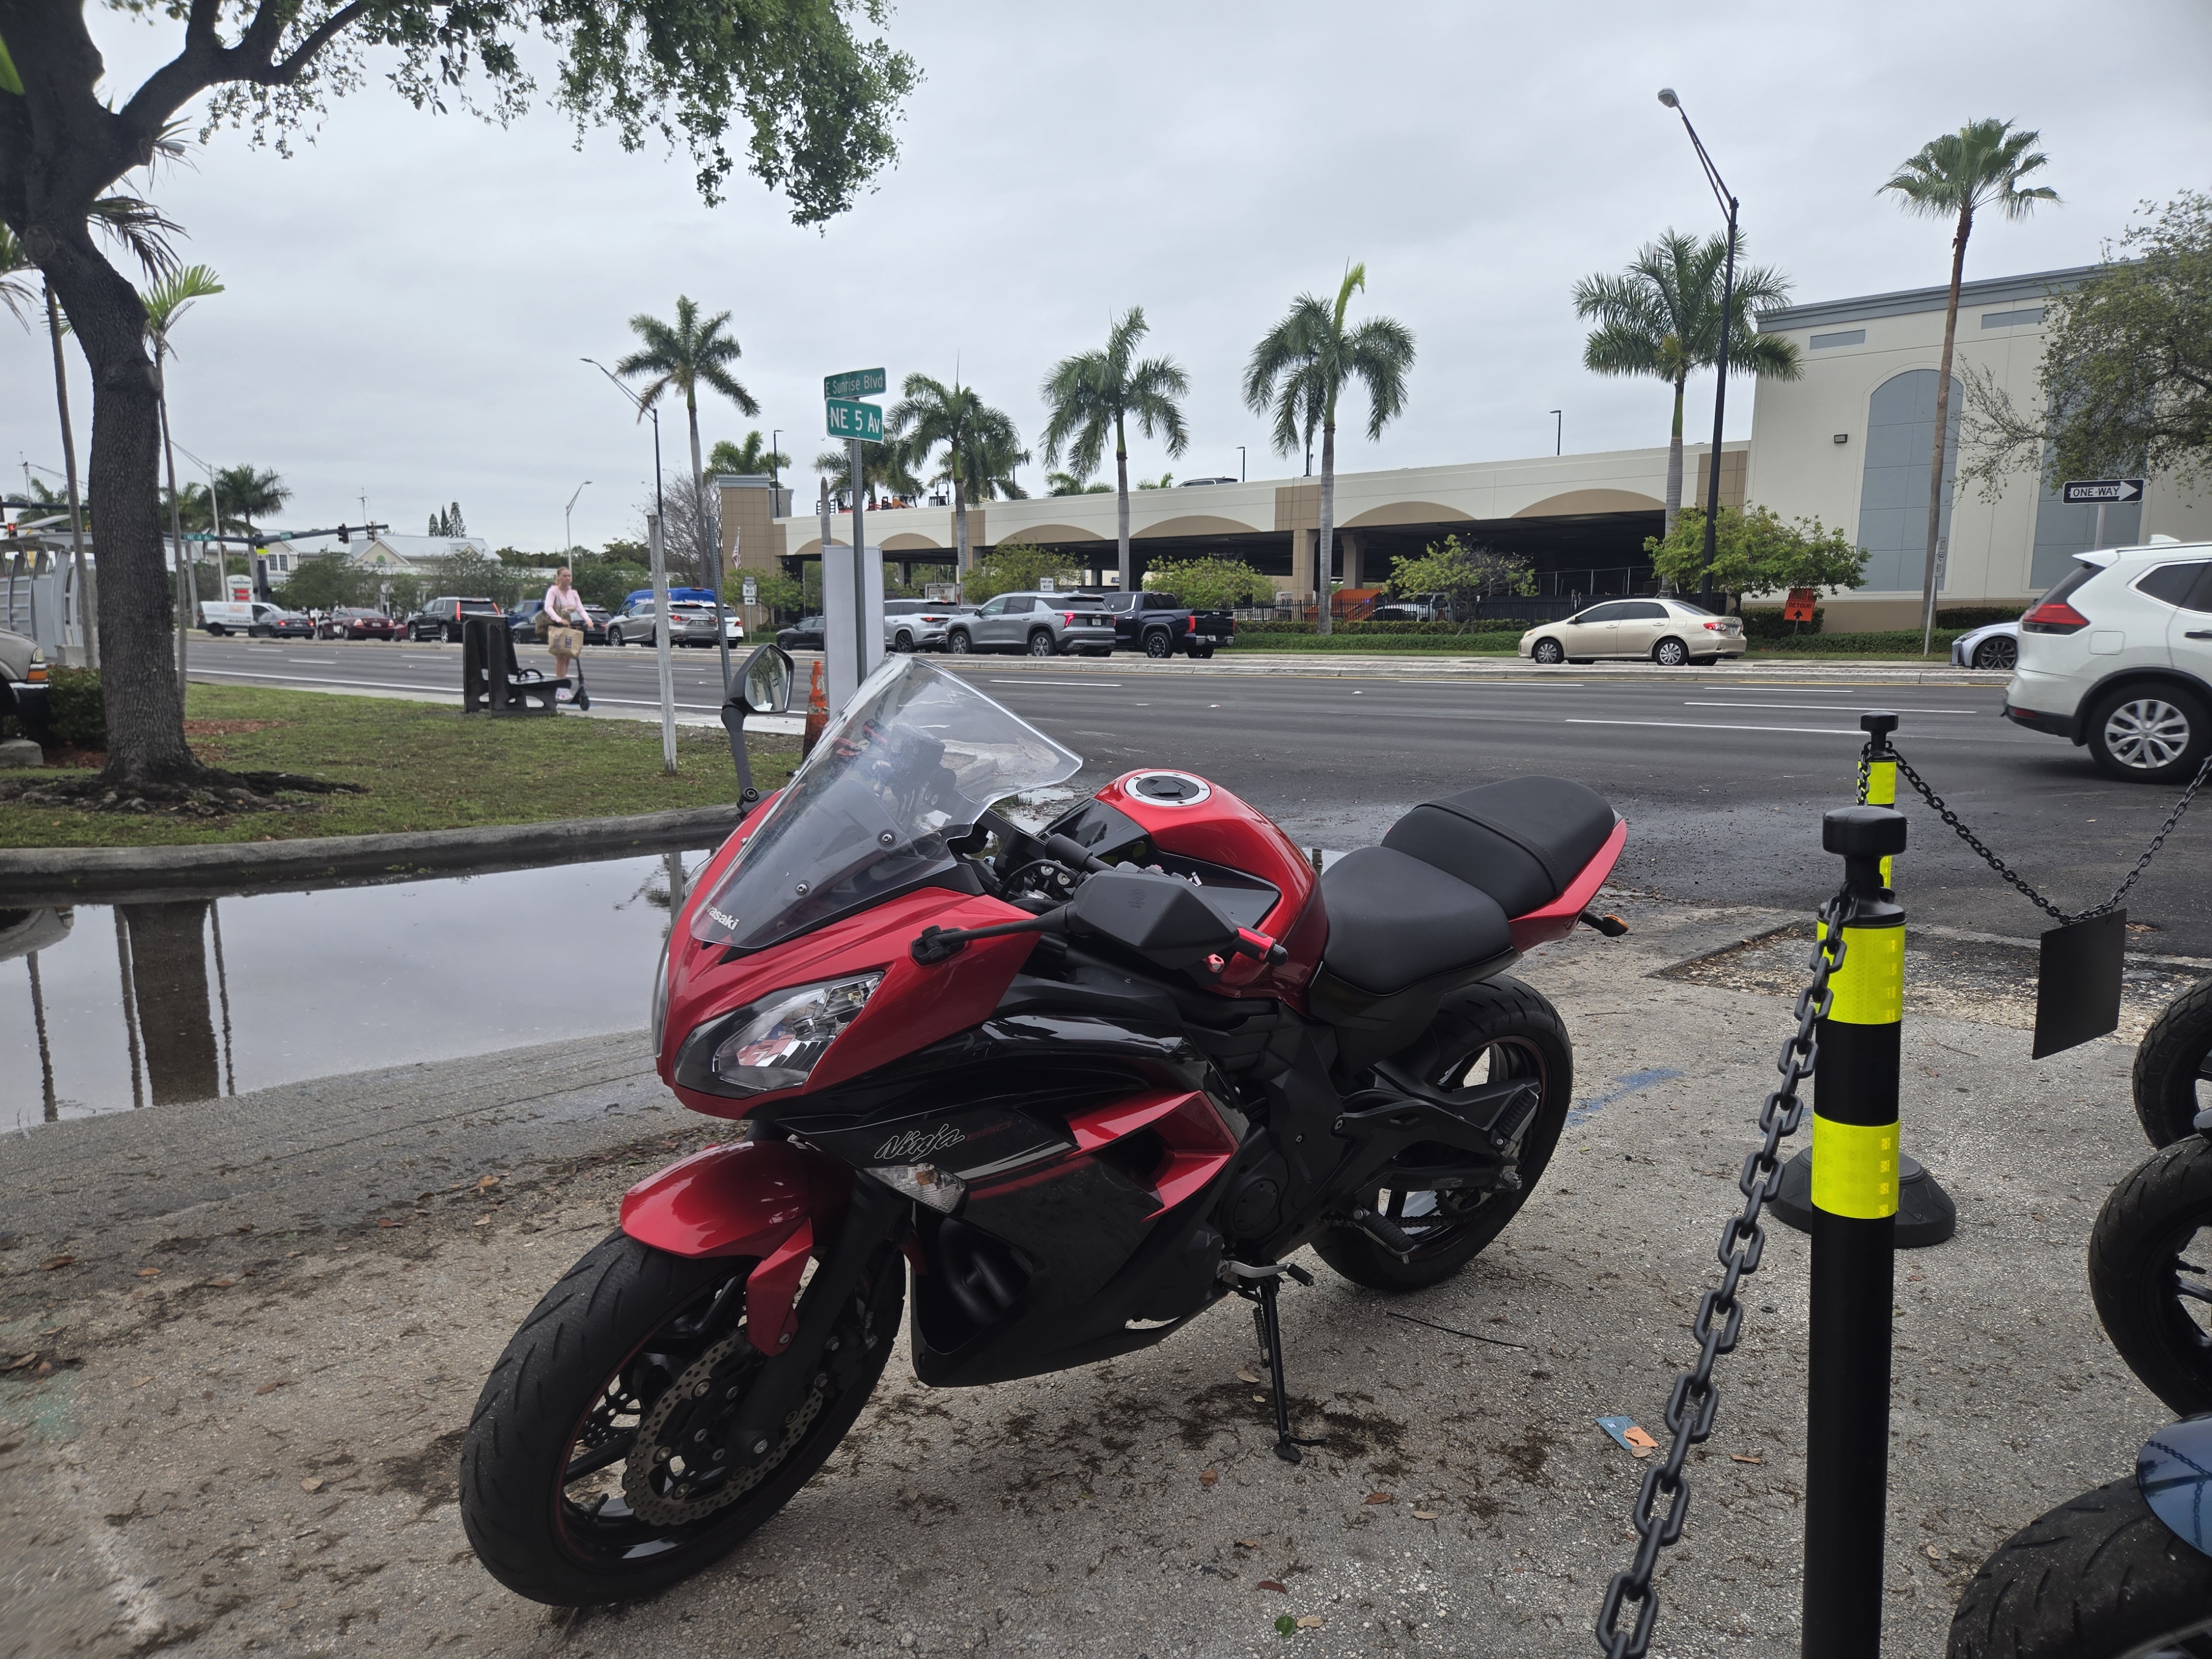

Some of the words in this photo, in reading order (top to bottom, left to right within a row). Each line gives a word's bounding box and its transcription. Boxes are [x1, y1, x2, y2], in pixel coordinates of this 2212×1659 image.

[826, 382, 830, 395] E
[833, 379, 860, 394] Sunrise
[864, 374, 883, 389] Blvd
[831, 406, 849, 429] NE
[855, 410, 863, 431] 5
[868, 412, 880, 434] Av
[2073, 488, 2094, 497] ONE
[2098, 487, 2120, 495] WAY
[874, 1124, 965, 1161] Ninja
